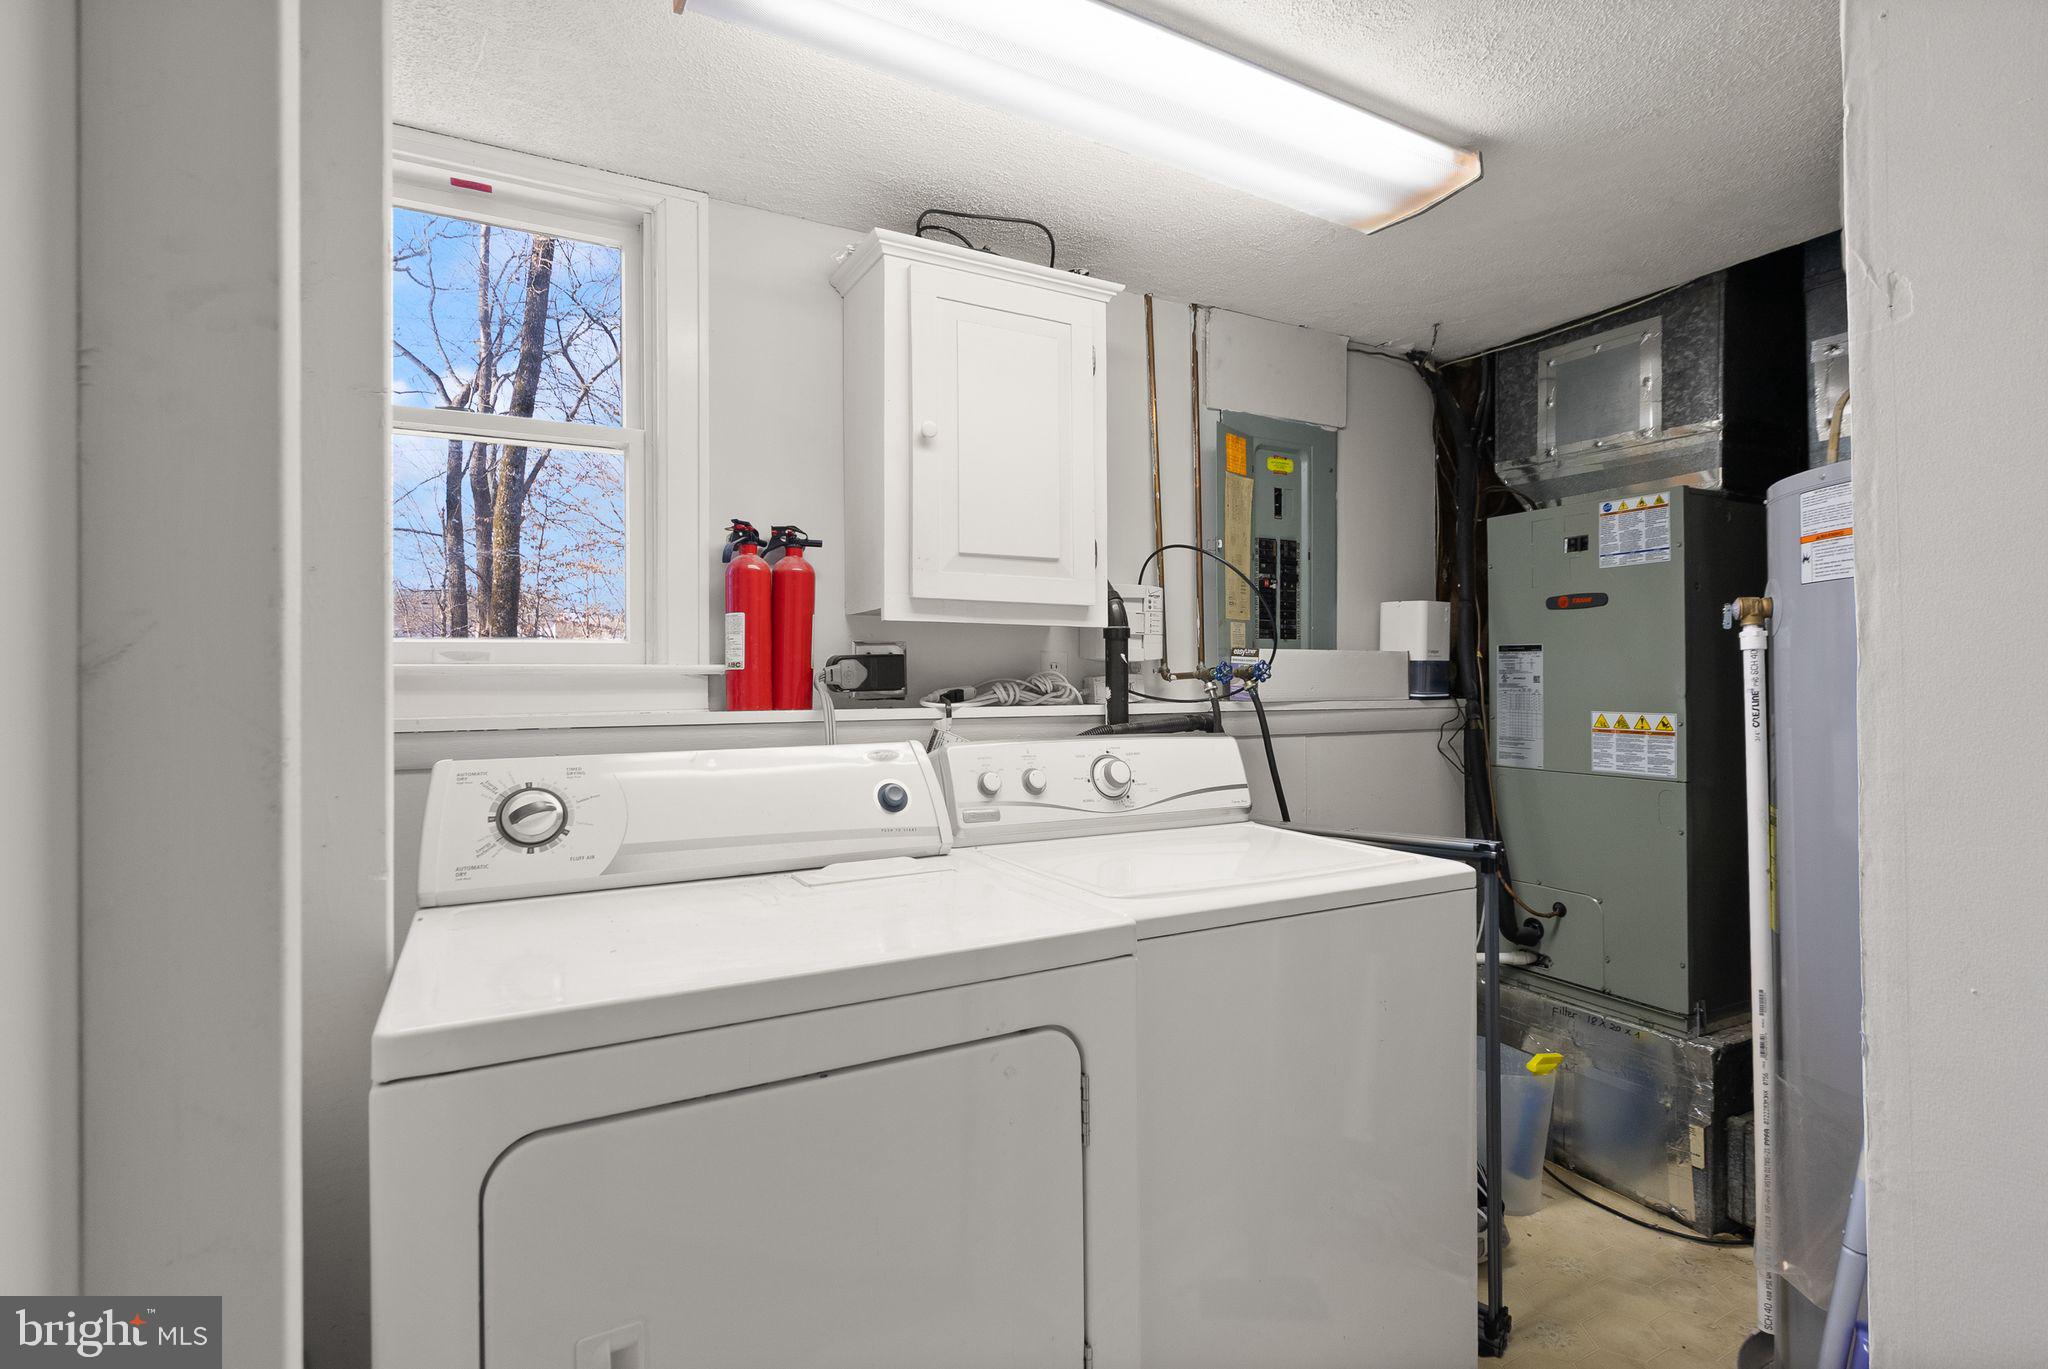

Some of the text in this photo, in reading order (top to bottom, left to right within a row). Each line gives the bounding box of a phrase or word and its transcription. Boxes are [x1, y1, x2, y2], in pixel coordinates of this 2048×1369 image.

[1750, 660, 1759, 676] SCH
[1552, 1006, 1578, 1019] Filter
[1609, 1023, 1621, 1032] 20
[1764, 1303, 1773, 1314] 40
[1764, 1314, 1773, 1331] SCH
